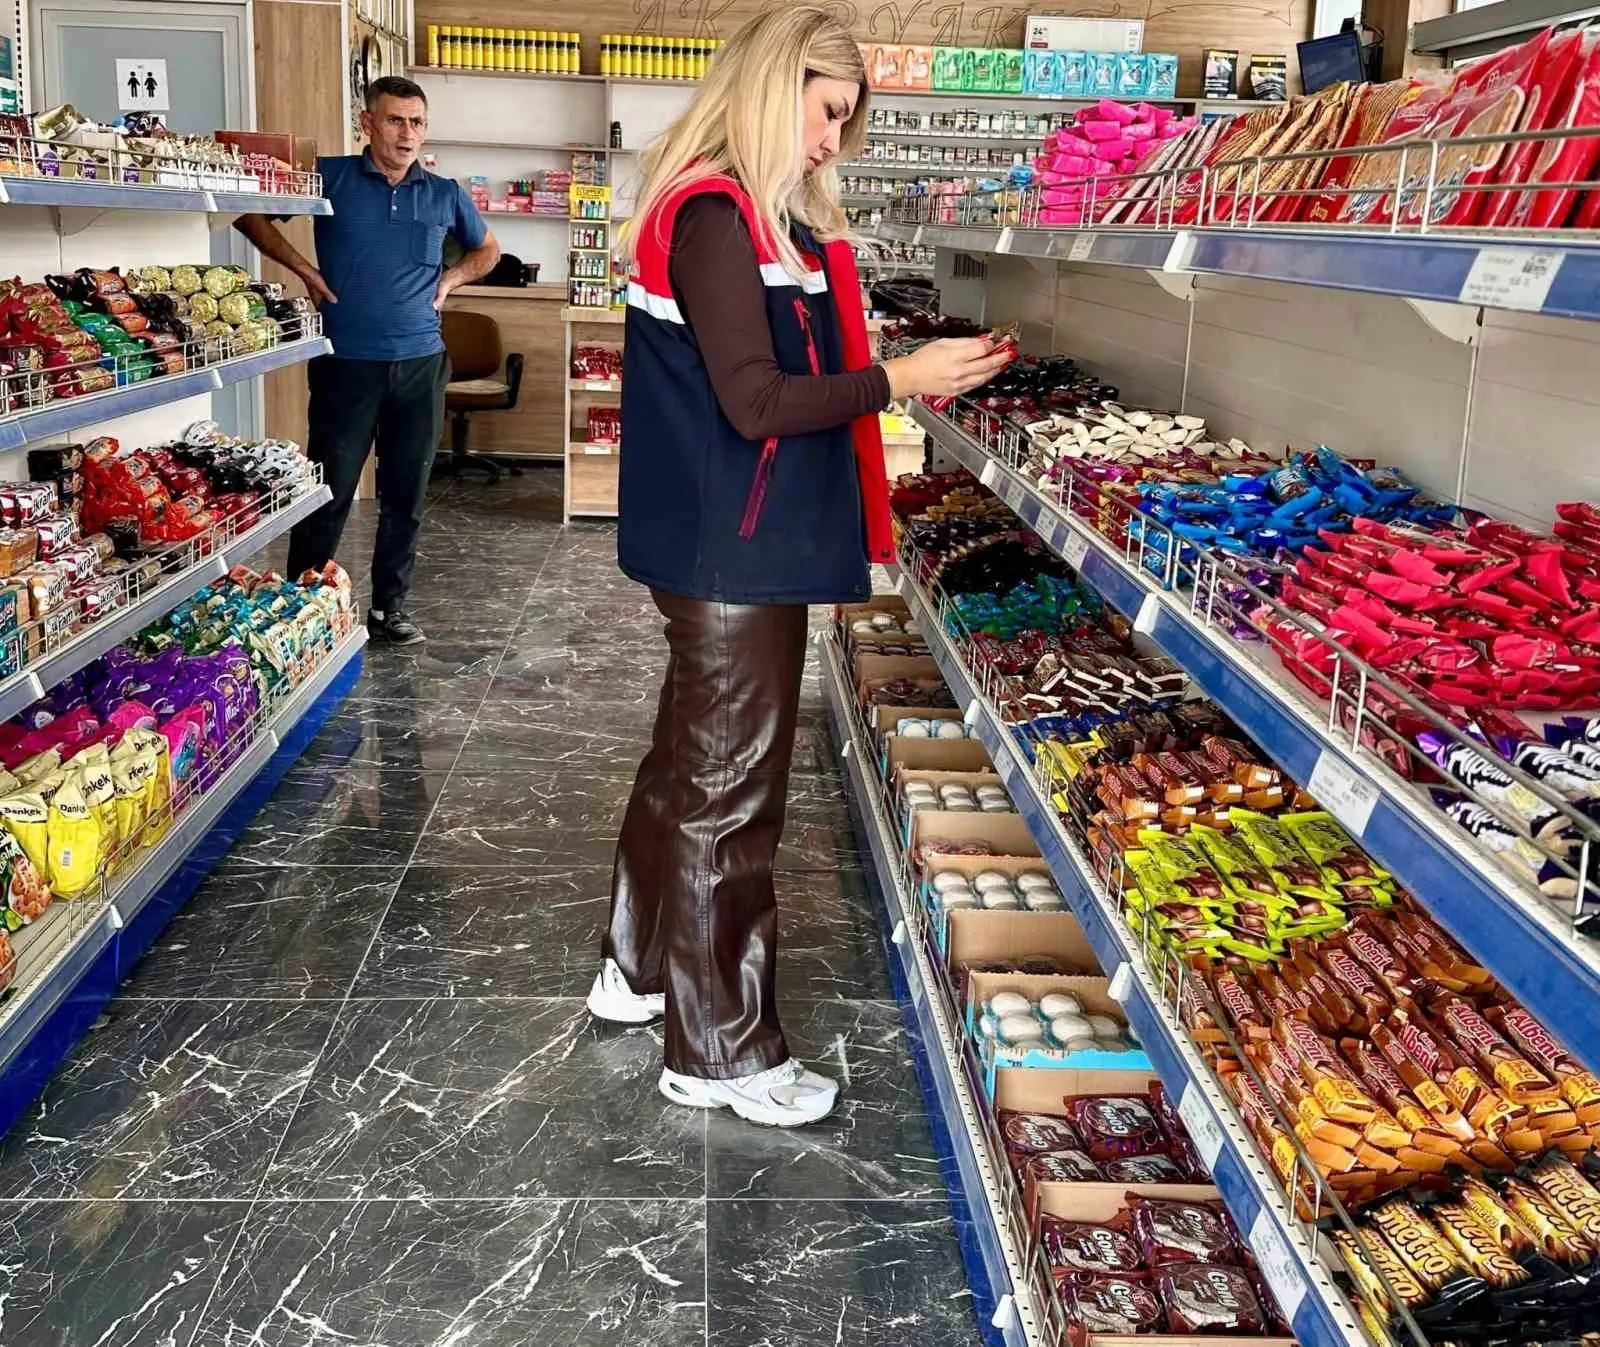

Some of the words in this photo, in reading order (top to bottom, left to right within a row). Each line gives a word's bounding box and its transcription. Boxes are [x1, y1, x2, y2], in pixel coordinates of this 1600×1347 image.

[54, 519, 75, 542] ikram
[1350, 932, 1392, 970] Albeni
[1330, 951, 1373, 993] Albeni
[1222, 980, 1251, 1019] Albeni
[1291, 1018, 1330, 1067] Albeni
[1453, 1004, 1498, 1048] Albeni
[1510, 1013, 1564, 1062] Albeni
[1093, 1230, 1121, 1266] Gong
[1374, 1203, 1453, 1275] metro
[1438, 1205, 1521, 1272] metro
[1111, 1284, 1140, 1320] Gong
[1208, 1271, 1240, 1308] Gong
